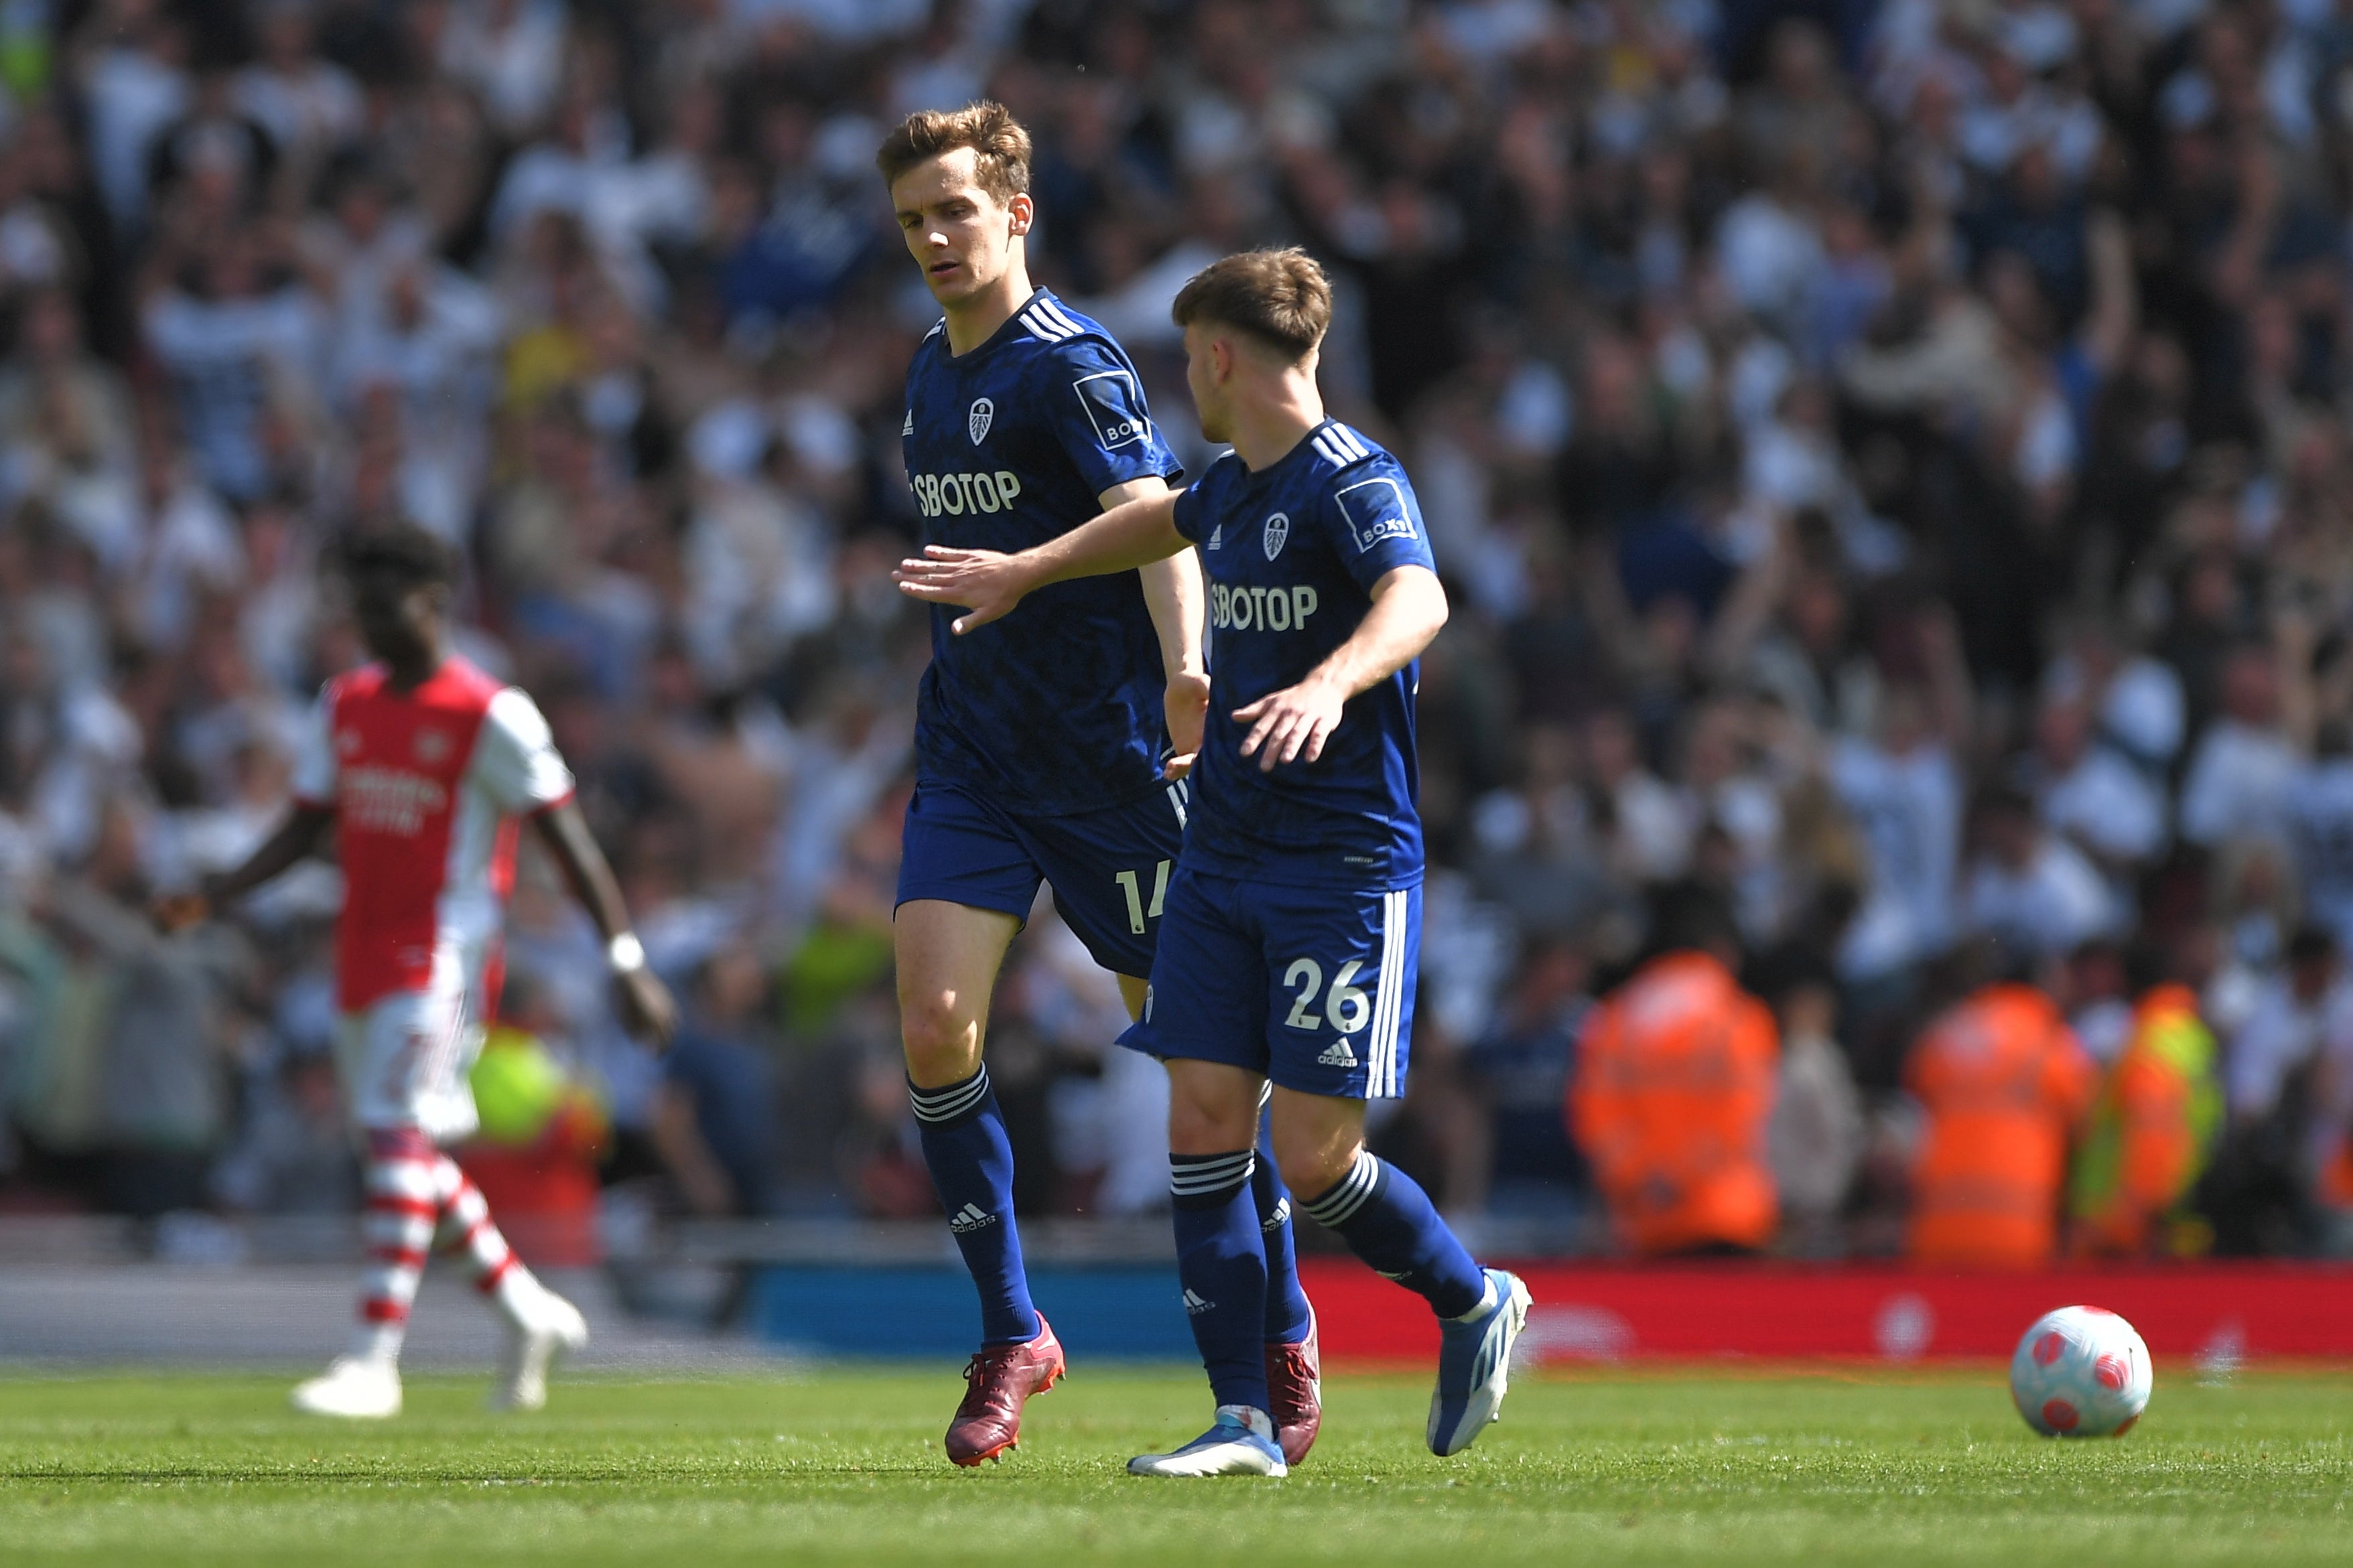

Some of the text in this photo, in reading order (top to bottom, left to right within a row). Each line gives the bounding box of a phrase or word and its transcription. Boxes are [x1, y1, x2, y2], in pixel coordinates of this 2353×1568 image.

[915, 471, 1021, 517] SBOTOP
[1211, 583, 1318, 632] SBOTOP
[1284, 958, 1371, 1034] 26
[1318, 1055, 1358, 1068] adidas
[951, 1214, 996, 1232] adidas
